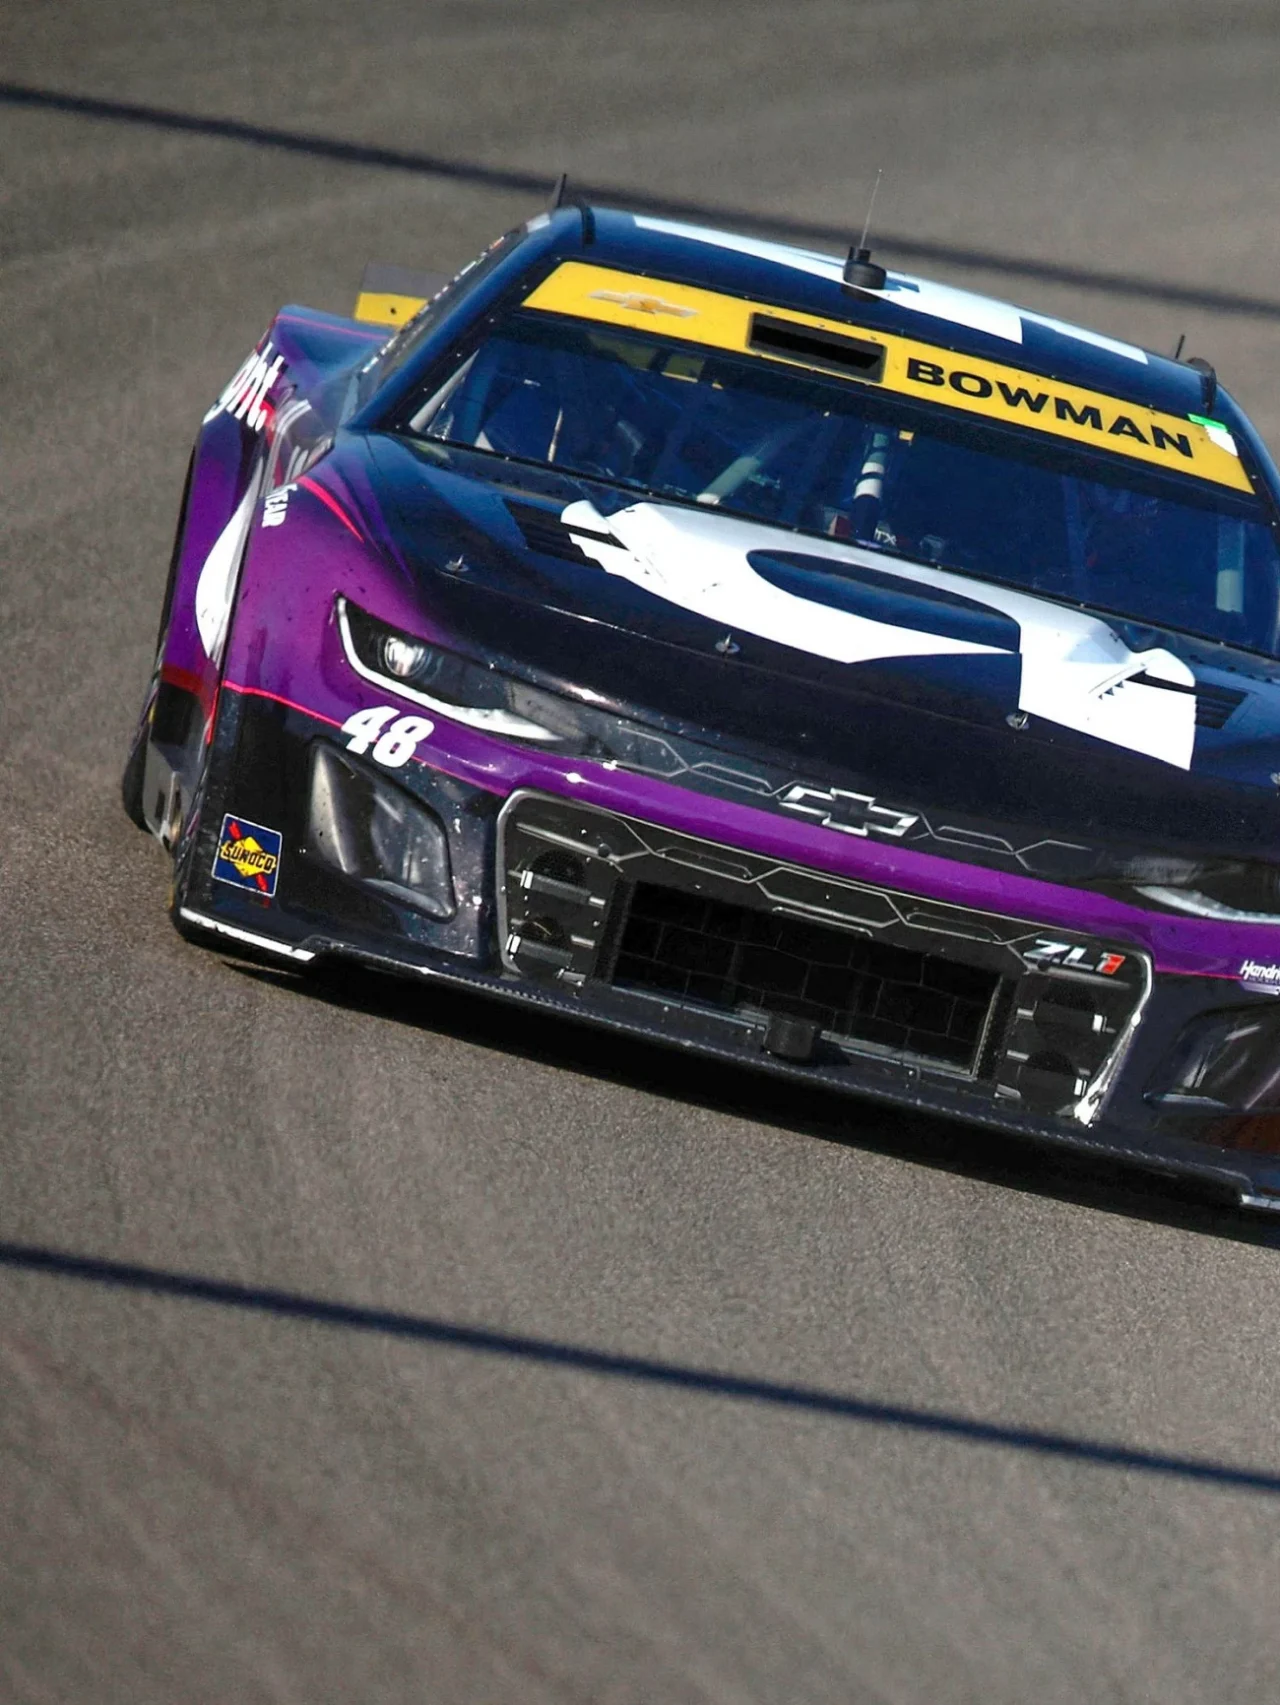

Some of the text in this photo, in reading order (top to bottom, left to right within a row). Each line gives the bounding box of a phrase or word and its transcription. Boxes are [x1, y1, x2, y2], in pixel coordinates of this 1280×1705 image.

[906, 357, 1194, 459] BOWMAN
[341, 705, 435, 768] 48
[222, 842, 275, 872] SUNOCO
[1023, 939, 1126, 975] ZL1
